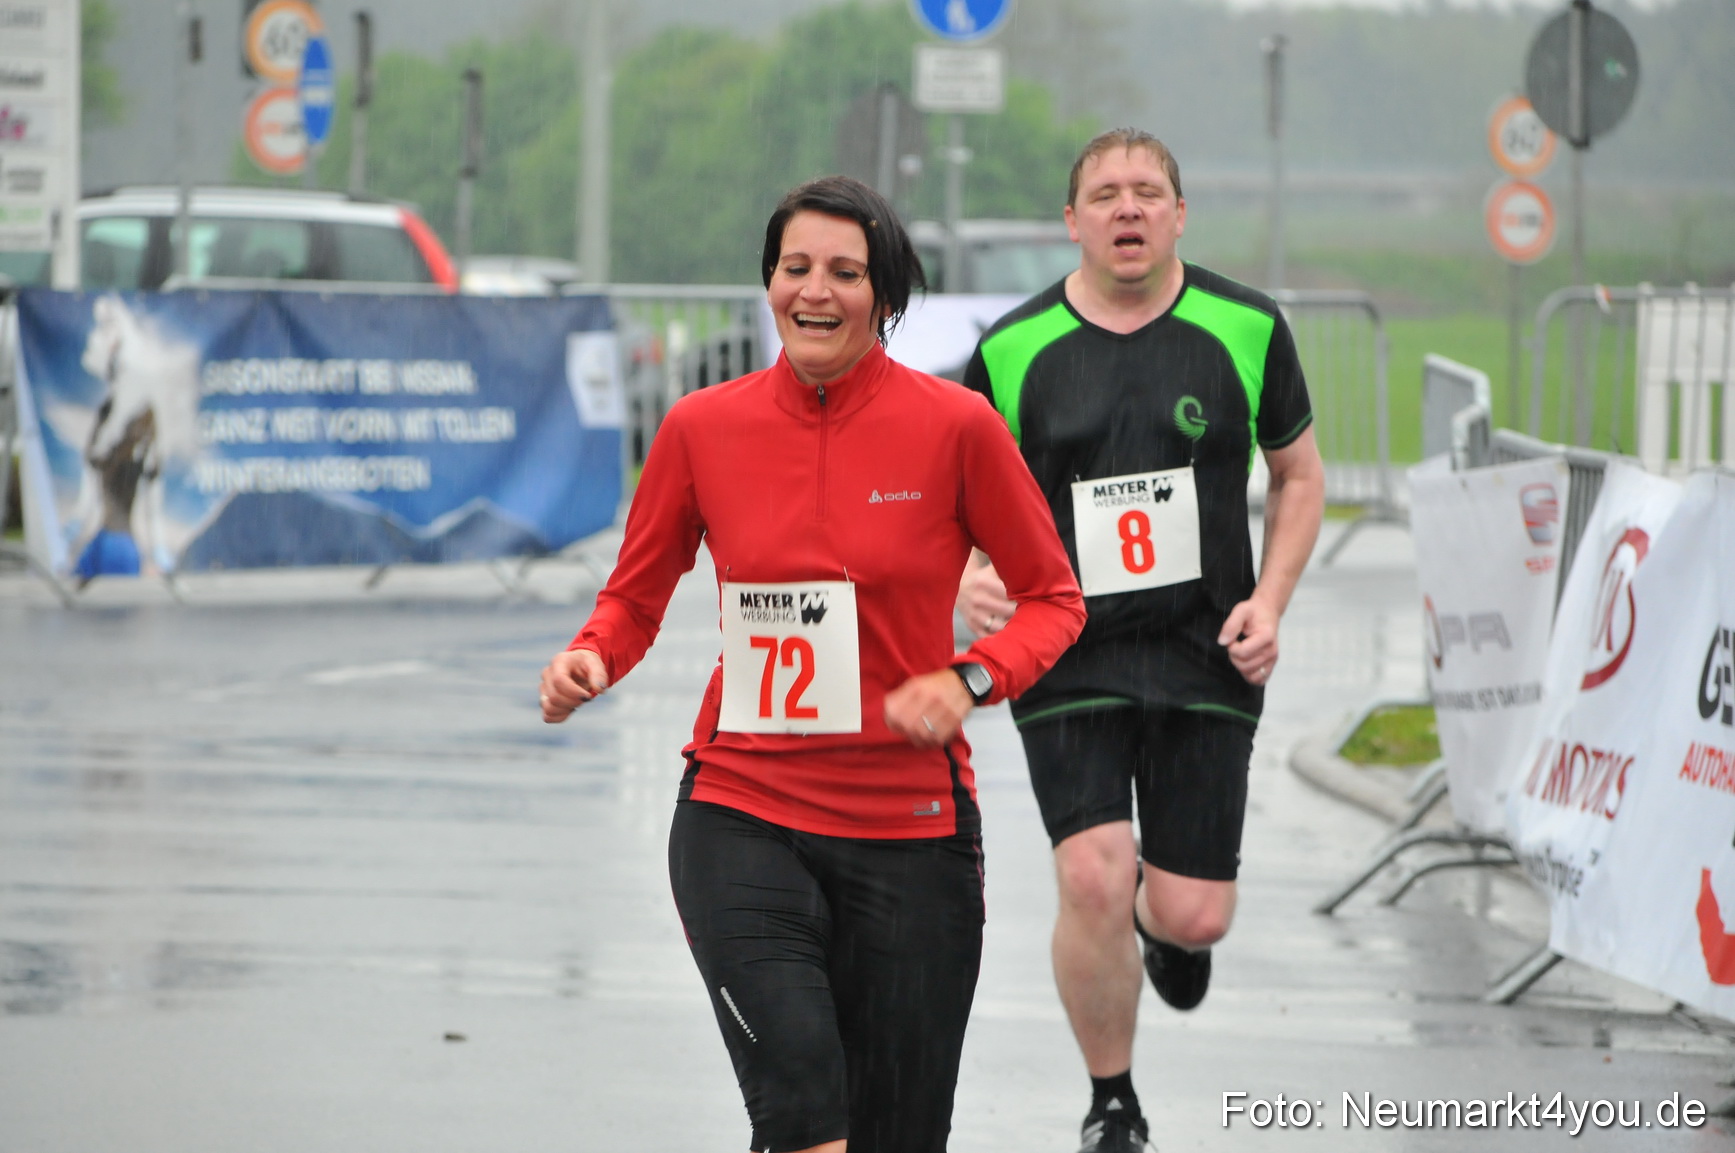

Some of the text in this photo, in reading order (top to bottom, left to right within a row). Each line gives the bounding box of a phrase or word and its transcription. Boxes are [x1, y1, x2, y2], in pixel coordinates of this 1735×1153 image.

[1093, 480, 1147, 498] MEYER
[1094, 493, 1150, 508] WERBUNG
[1117, 509, 1156, 575] 8
[740, 592, 794, 608] MEYER
[741, 608, 796, 624] WERBUNG
[750, 636, 819, 719] 72
